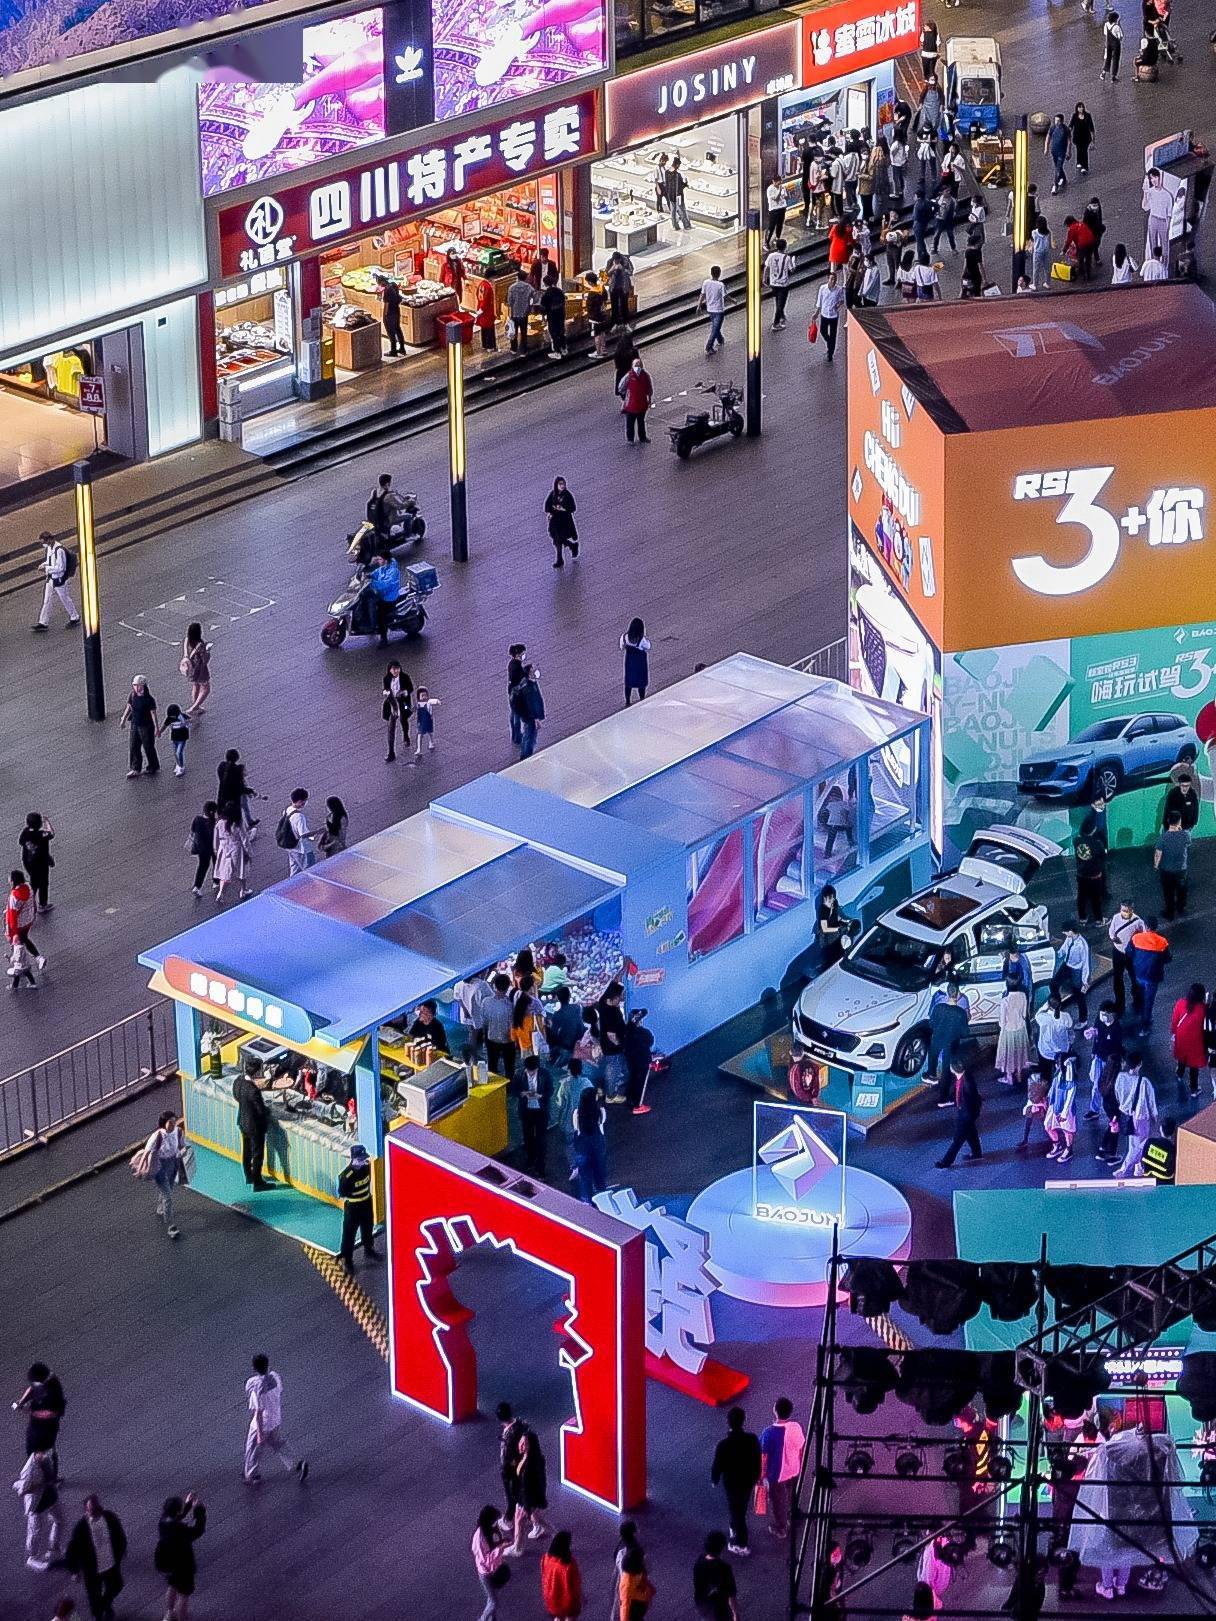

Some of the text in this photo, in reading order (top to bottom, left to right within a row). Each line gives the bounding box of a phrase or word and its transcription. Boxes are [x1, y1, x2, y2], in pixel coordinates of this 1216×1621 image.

[834, 2, 916, 58] 蜜雪冰城
[658, 56, 756, 114] JOSINY
[310, 104, 581, 241] 四川特产专卖
[1090, 664, 1181, 704] 嗨玩试驾
[755, 1203, 842, 1227] BAOJUN
